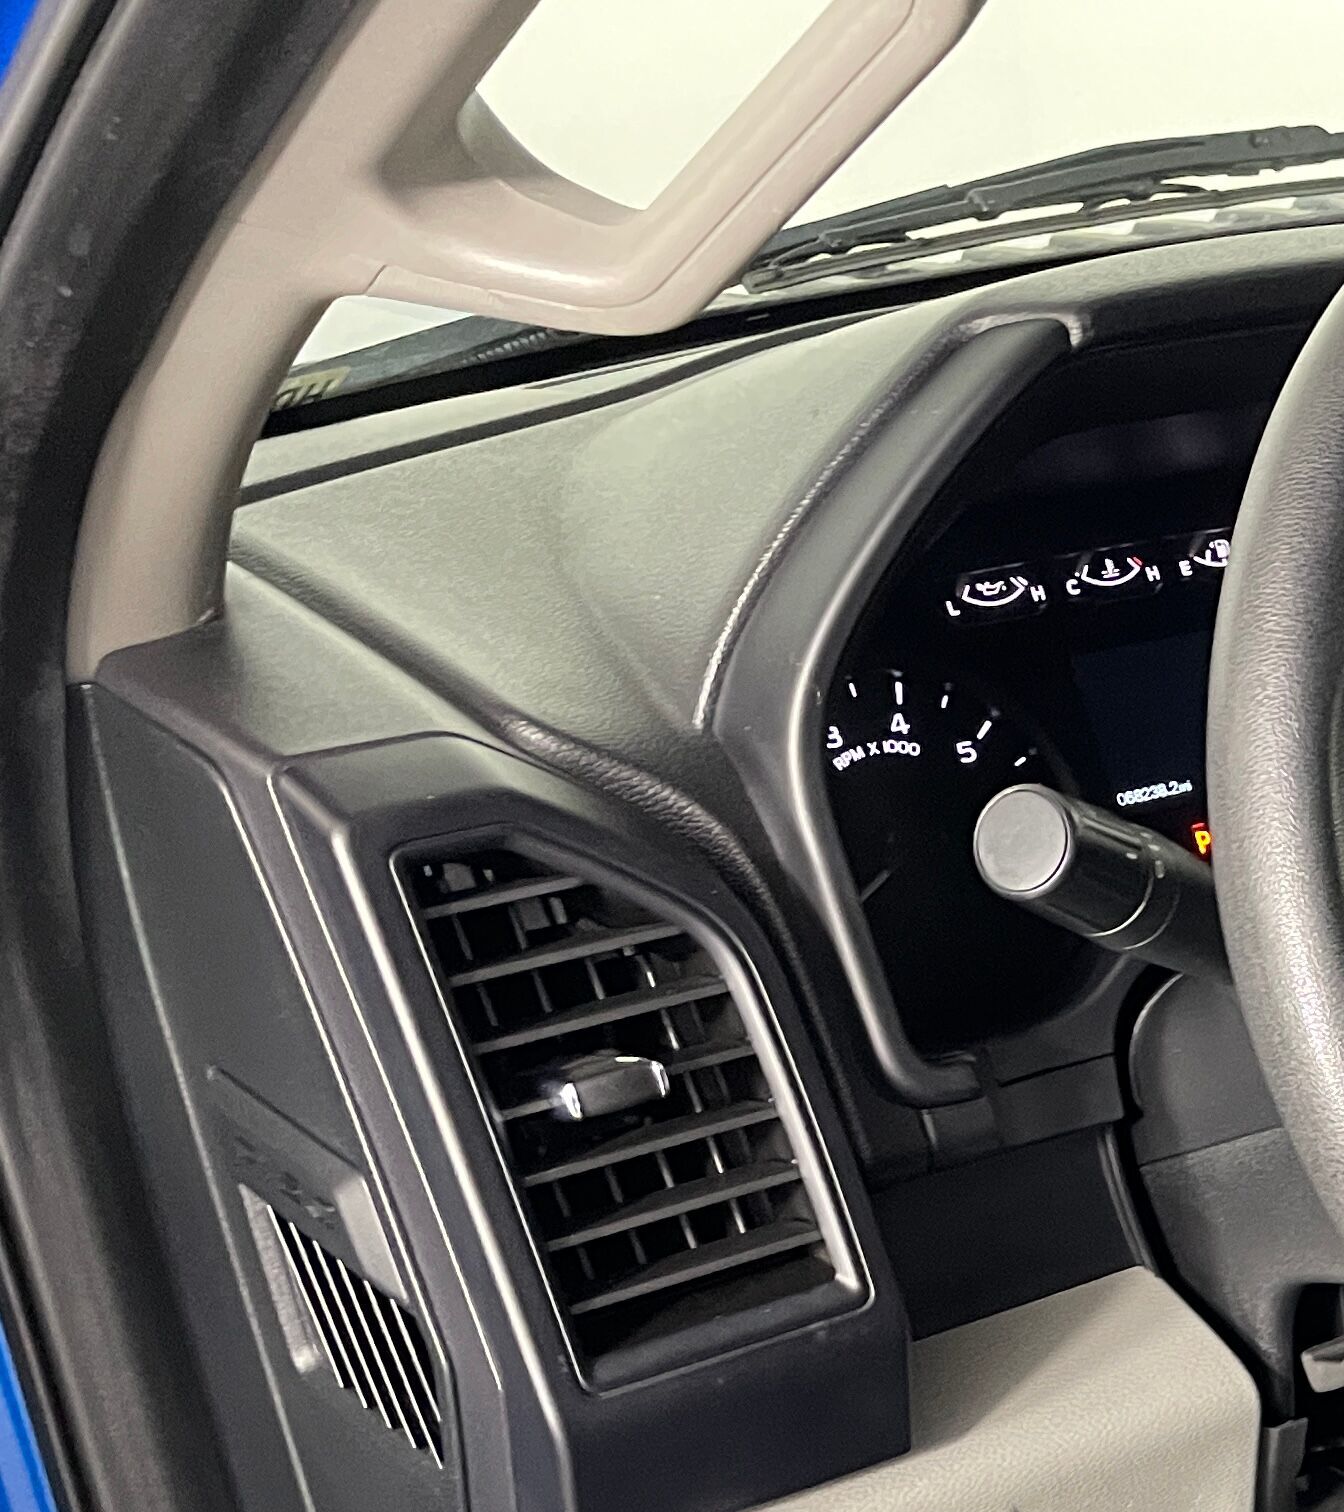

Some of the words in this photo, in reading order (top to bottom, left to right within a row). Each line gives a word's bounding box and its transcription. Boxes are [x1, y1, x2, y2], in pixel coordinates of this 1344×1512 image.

[1146, 565, 1161, 581] H
[1179, 560, 1193, 576] E
[1030, 584, 1046, 602] H
[1066, 578, 1081, 596] C
[945, 601, 960, 616] L
[891, 713, 910, 735] 4
[826, 726, 843, 748] 3
[832, 745, 866, 771] RPM
[882, 739, 921, 756] 1000
[956, 741, 977, 763] 5
